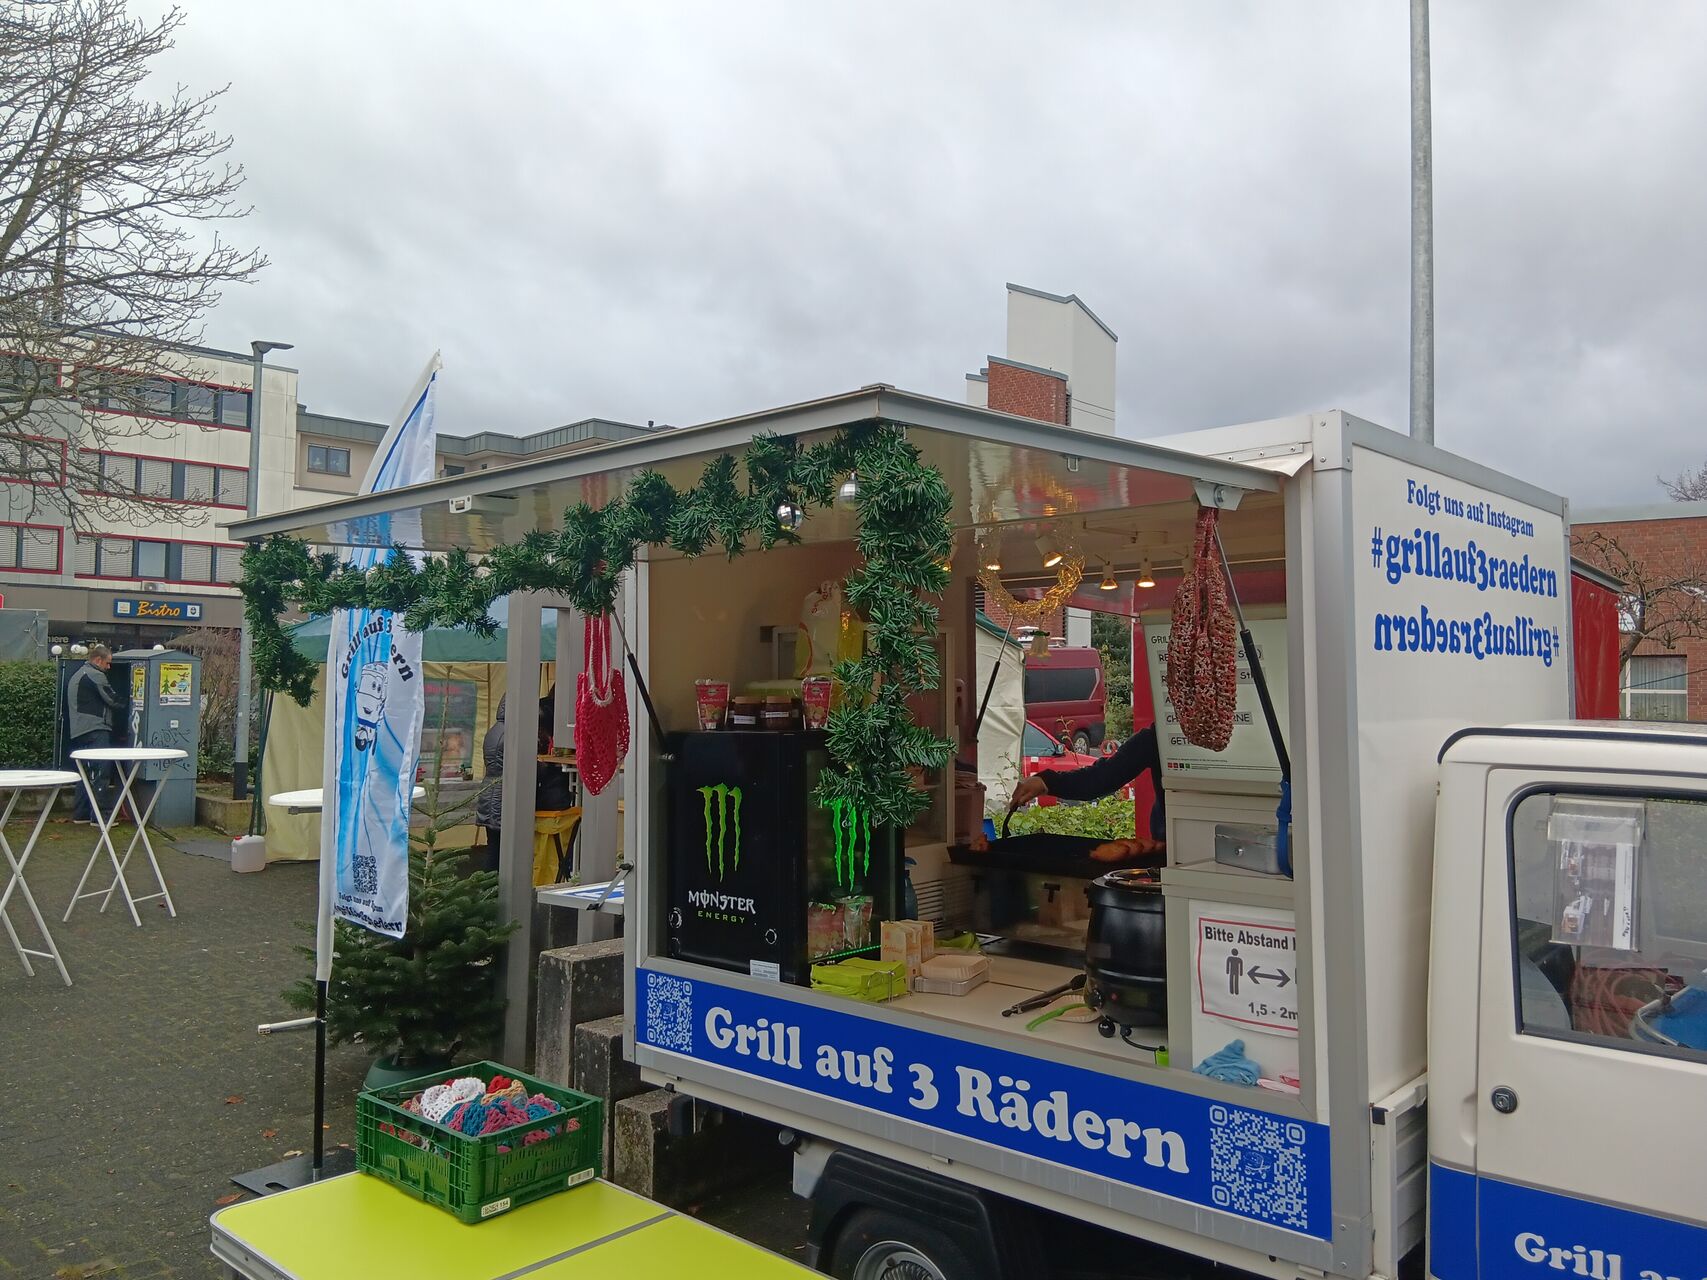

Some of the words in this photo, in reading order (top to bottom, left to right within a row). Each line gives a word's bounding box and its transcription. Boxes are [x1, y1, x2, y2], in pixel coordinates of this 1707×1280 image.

[1407, 479, 1441, 516] Folgt
[1443, 496, 1464, 518] uns
[1466, 502, 1485, 523] auf
[1486, 503, 1534, 538] Instagram
[1371, 526, 1558, 598] #grillauf3raedern
[137, 600, 181, 617] Bistro
[341, 631, 361, 679] Grill
[362, 616, 384, 639] auf
[386, 618, 393, 634] 3
[390, 643, 414, 682] ern
[688, 889, 756, 914] MONSTER
[698, 910, 745, 924] ENERGY
[1205, 926, 1234, 942] Bitte
[1237, 930, 1288, 950] Abstand
[1248, 1002, 1268, 1017] 1,5
[1280, 1006, 1298, 1020] 2m
[705, 1007, 802, 1070] Grill
[816, 1045, 894, 1094] auf
[908, 1063, 940, 1110] 3
[956, 1065, 1189, 1174] Rädern
[1514, 1232, 1621, 1280] Grill
